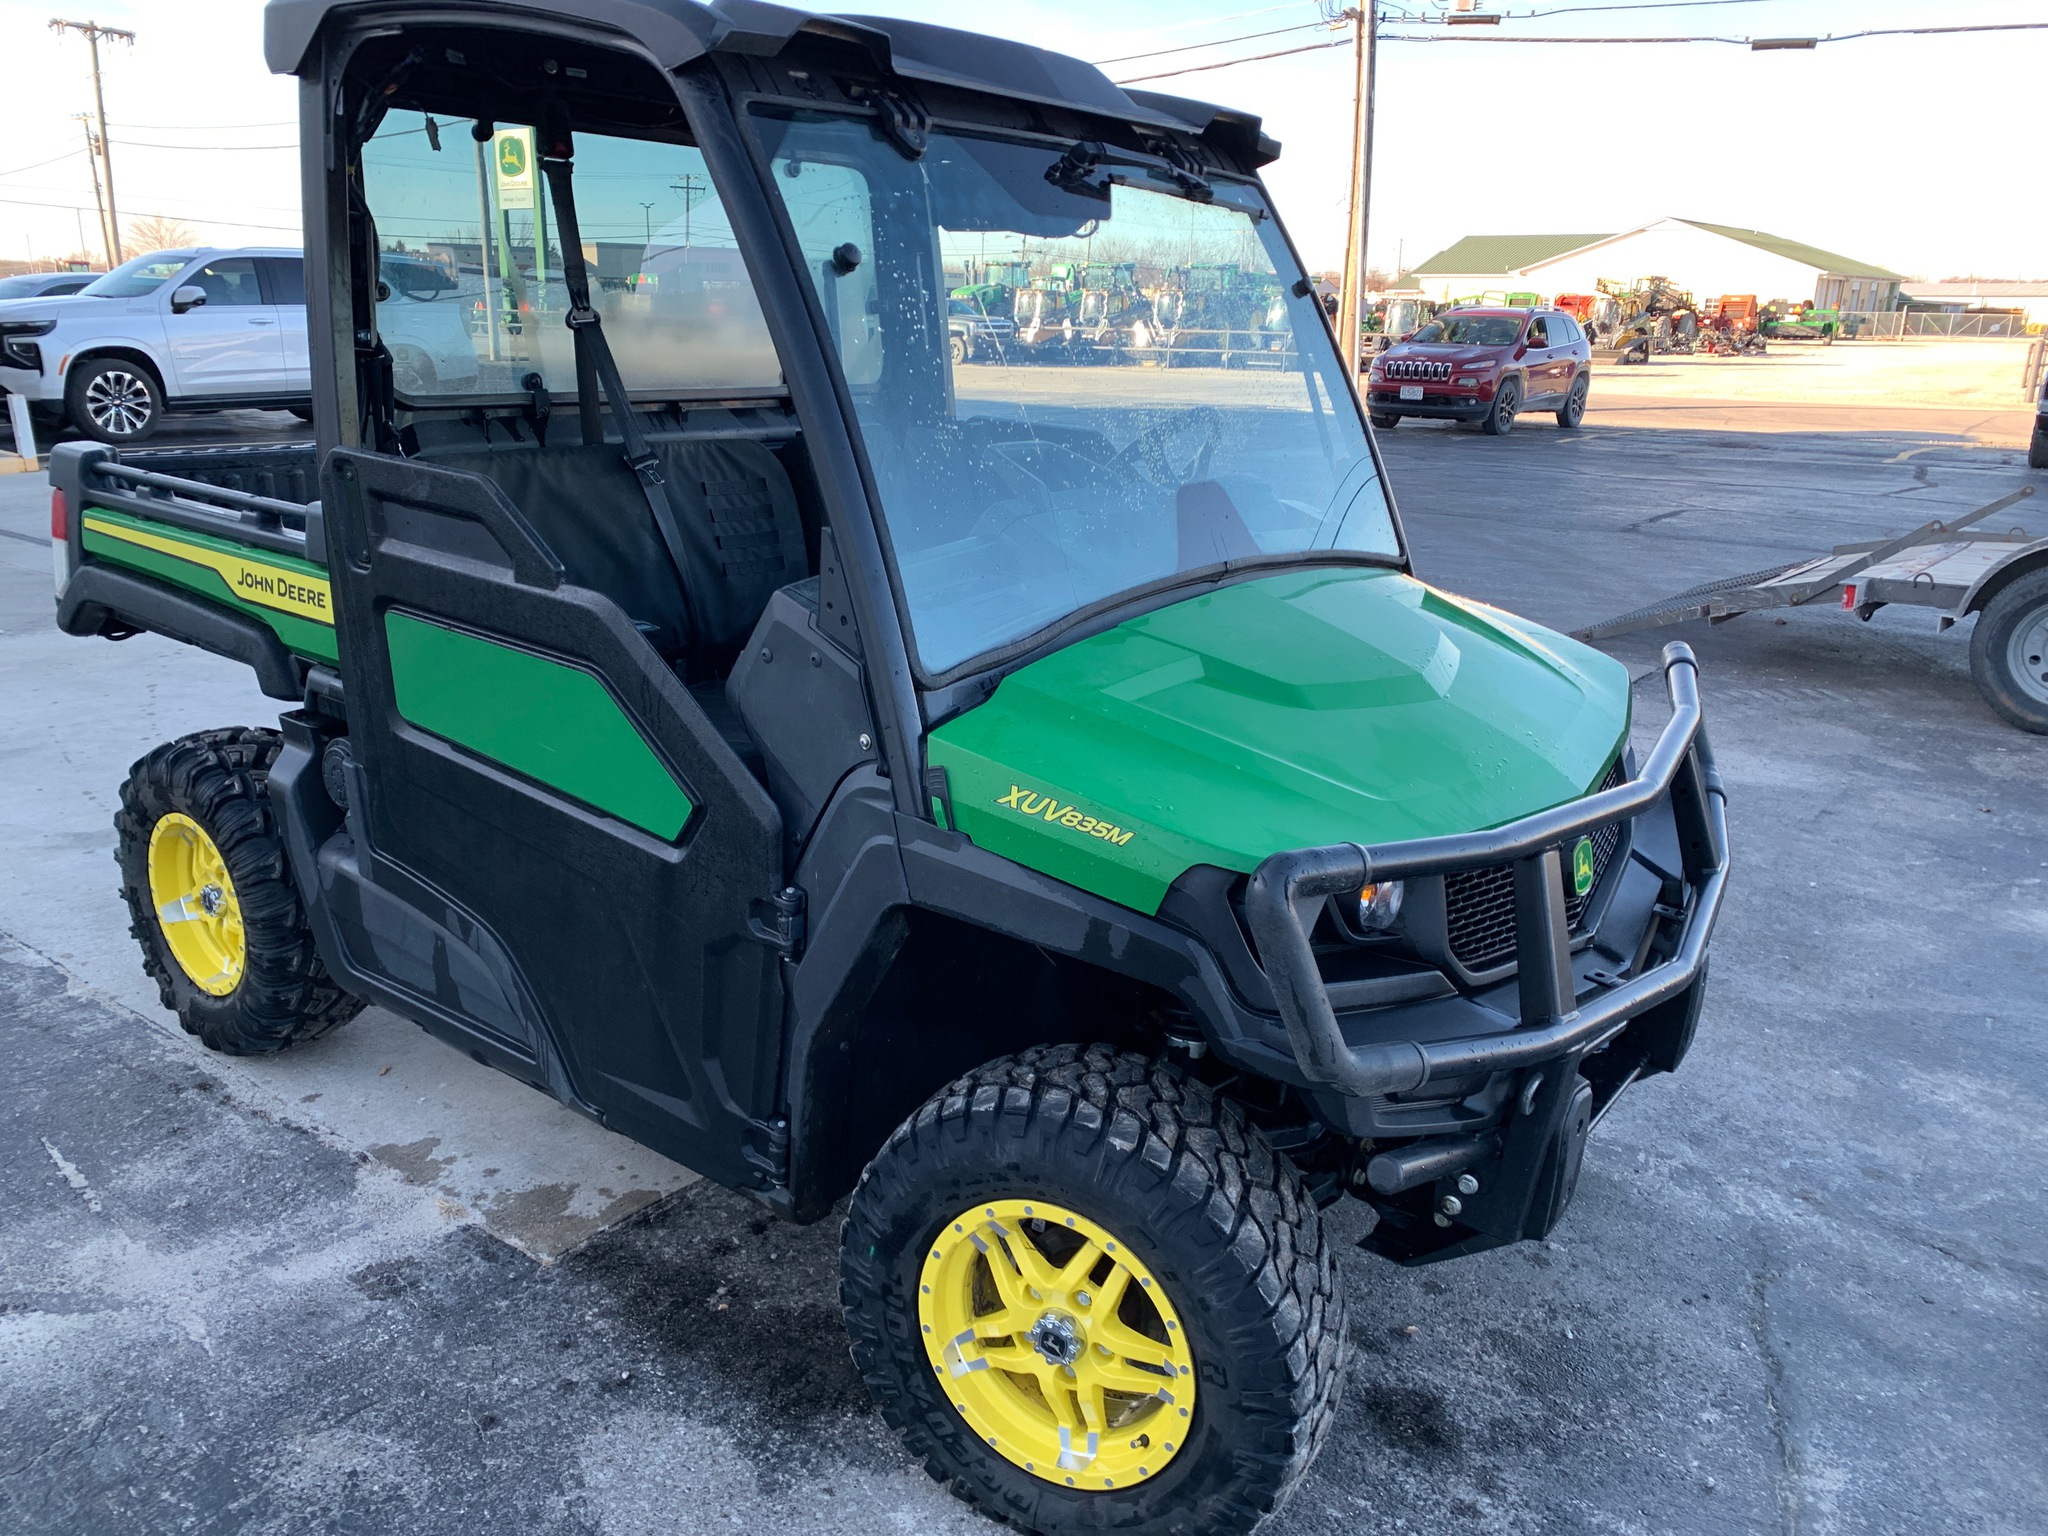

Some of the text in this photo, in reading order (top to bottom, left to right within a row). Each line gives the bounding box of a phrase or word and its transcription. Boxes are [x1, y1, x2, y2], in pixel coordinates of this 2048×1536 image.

[237, 567, 326, 609] JOHN DEERE
[995, 784, 1136, 847] XUV835M
